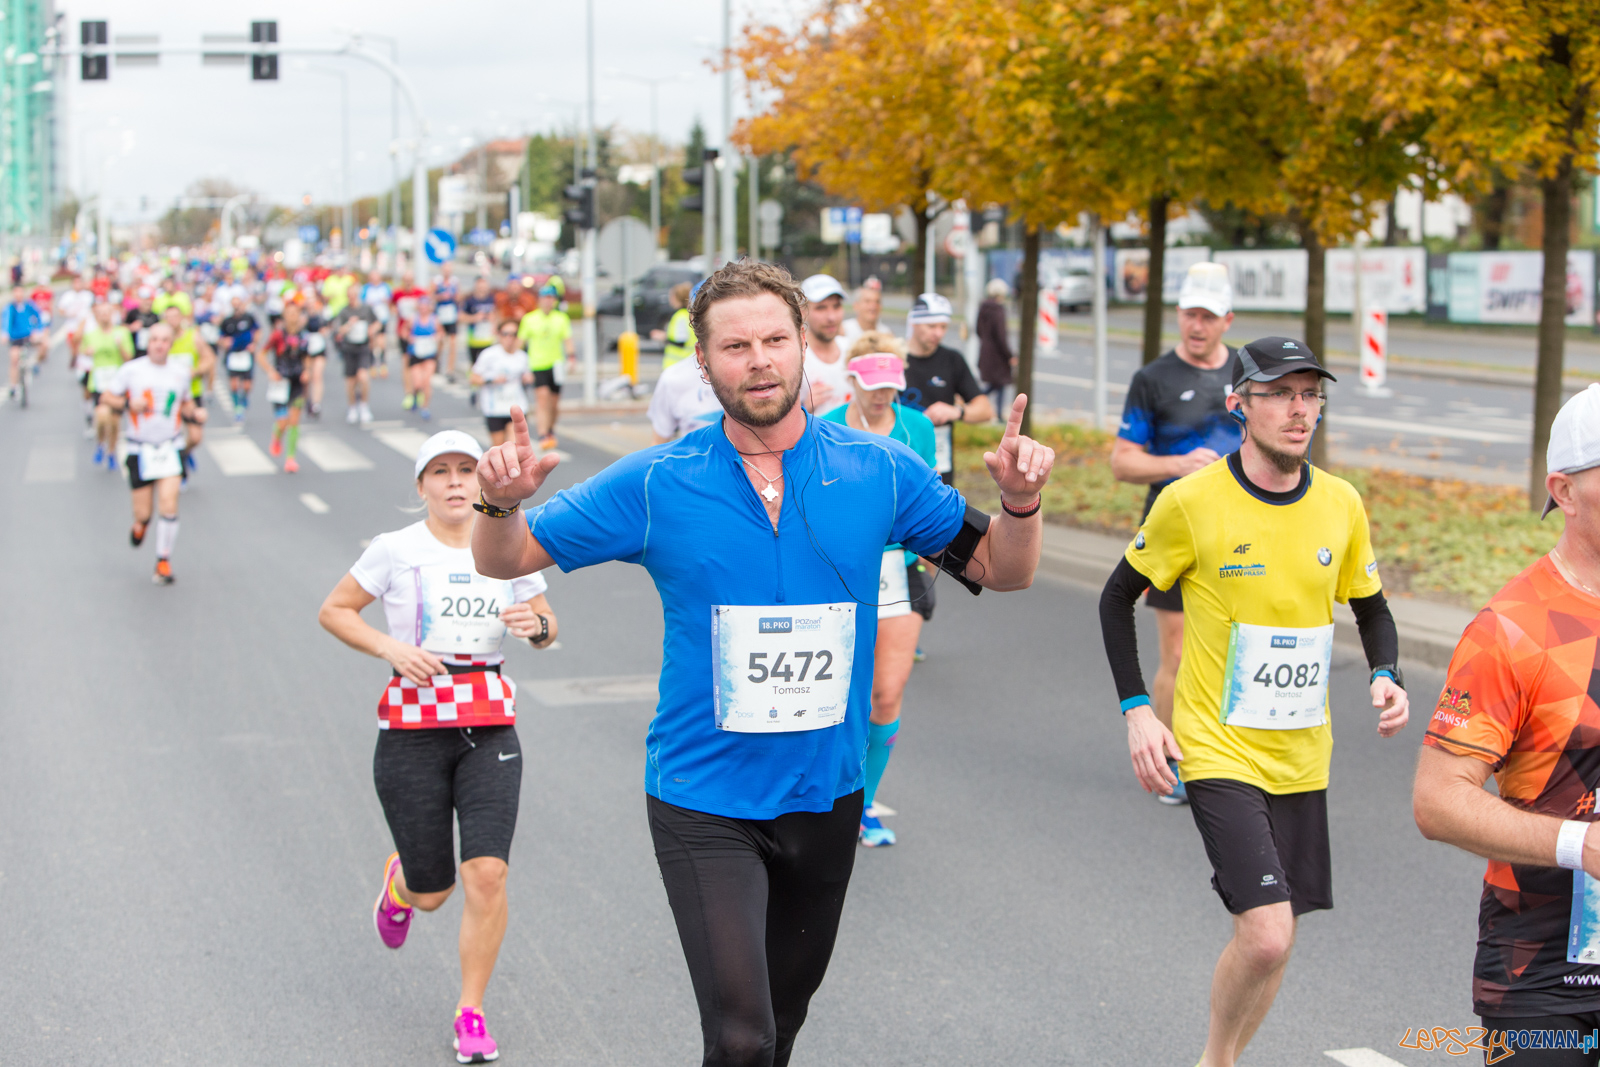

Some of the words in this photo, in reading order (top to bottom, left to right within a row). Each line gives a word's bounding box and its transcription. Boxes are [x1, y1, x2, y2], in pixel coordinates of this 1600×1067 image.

[1233, 543, 1252, 554] 4F
[1219, 570, 1243, 578] BMW
[441, 596, 500, 618] 2024
[762, 621, 773, 629] 18.
[774, 621, 790, 629] PKO
[1282, 638, 1295, 646] PKO
[747, 649, 833, 684] 5472
[1253, 661, 1320, 688] 4082
[772, 685, 811, 695] Tomasz
[1275, 690, 1303, 698] Bartosz
[1434, 710, 1470, 729] GDAŃSK
